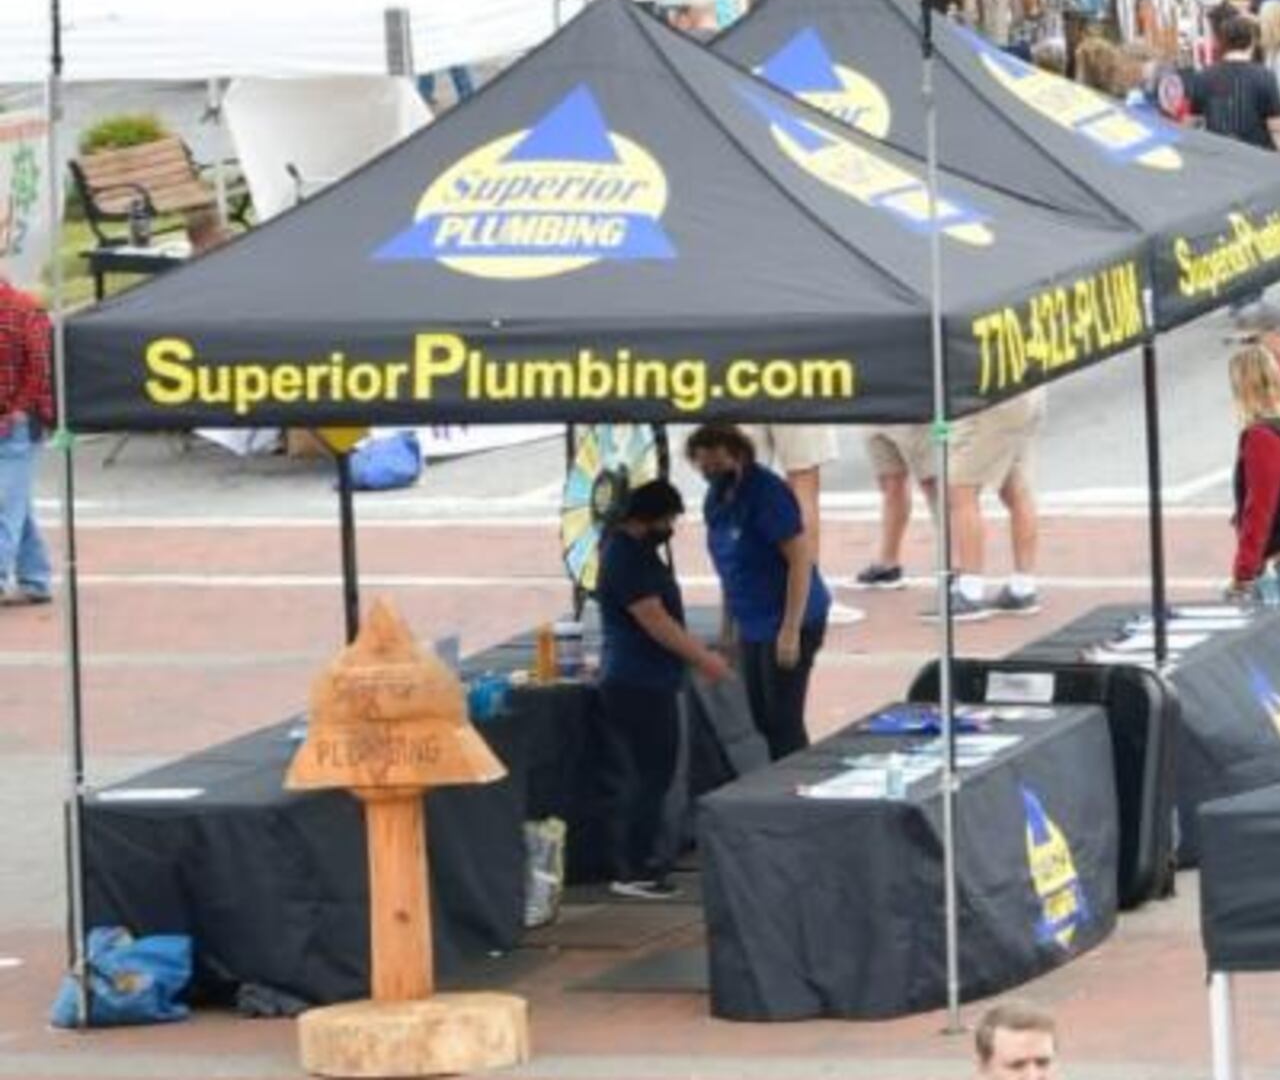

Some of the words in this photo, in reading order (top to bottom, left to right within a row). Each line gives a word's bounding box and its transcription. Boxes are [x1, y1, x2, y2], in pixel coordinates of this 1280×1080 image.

[442, 168, 650, 206] Superior
[433, 215, 629, 247] PLUMBING
[142, 332, 854, 414] SuperiorPlumbing.com
